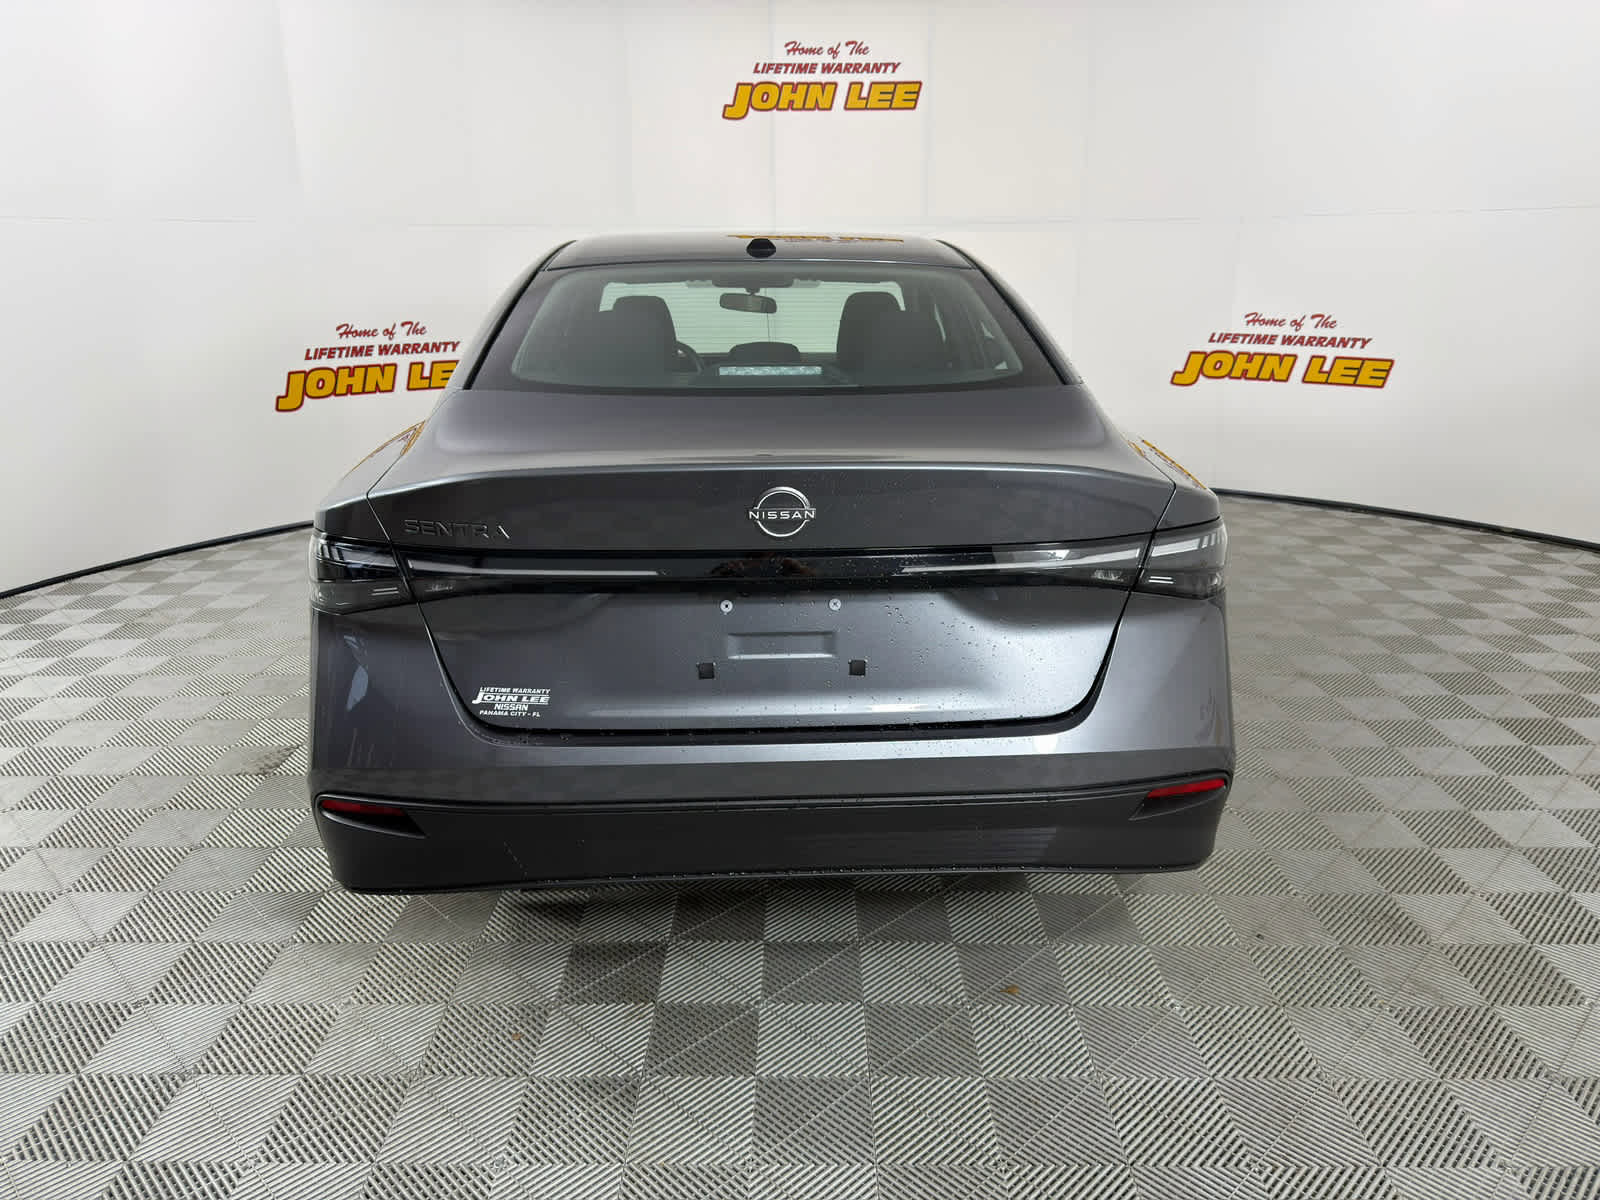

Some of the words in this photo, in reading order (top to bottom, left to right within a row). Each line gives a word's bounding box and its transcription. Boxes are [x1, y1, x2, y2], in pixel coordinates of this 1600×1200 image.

[784, 41, 823, 56] Home
[827, 42, 841, 59] of
[845, 41, 869, 56] The
[753, 63, 817, 74] LIFETIME
[821, 62, 901, 74] WARRANTY
[722, 81, 838, 120] JOHN
[844, 81, 922, 110] LEE
[335, 324, 378, 339] Home
[383, 323, 396, 340] of
[400, 321, 427, 336] The
[1244, 312, 1286, 327] Home
[1290, 315, 1305, 331] of
[1310, 314, 1338, 329] The
[1208, 332, 1279, 345] LIFETIME
[1281, 335, 1372, 349] WARRANTY
[304, 345, 374, 361] LIFETIME
[378, 341, 460, 356] WARRANTY
[1170, 350, 1297, 387] JOHN
[1302, 356, 1395, 389] LEE
[275, 363, 397, 412] JOHN
[406, 360, 459, 391] LE
[748, 510, 816, 520] NISSAN
[404, 519, 510, 539] SENTRA
[471, 692, 518, 704] JOHN
[521, 695, 550, 703] LEE
[493, 703, 528, 711] NISSAN
